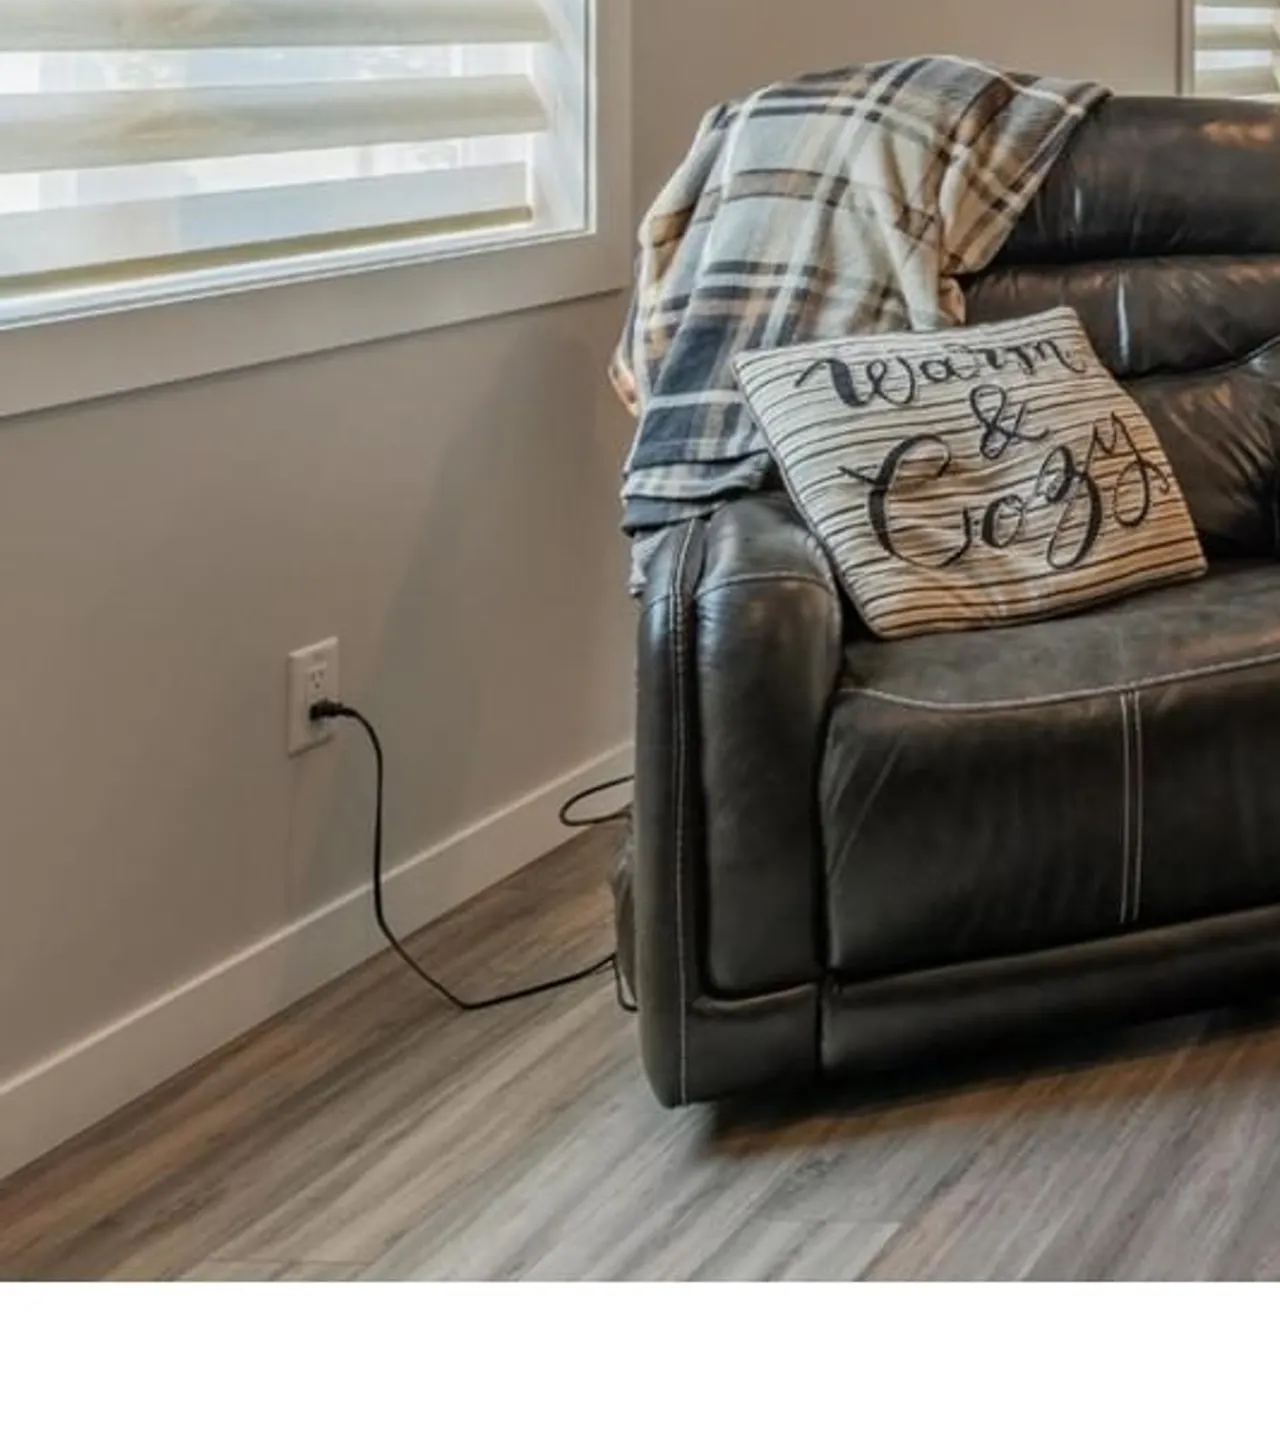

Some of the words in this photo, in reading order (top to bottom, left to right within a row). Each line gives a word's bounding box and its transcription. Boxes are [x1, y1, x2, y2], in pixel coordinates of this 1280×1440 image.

[795, 338, 1085, 408] Warm
[969, 384, 1048, 459] &
[838, 411, 1171, 570] Cozy
